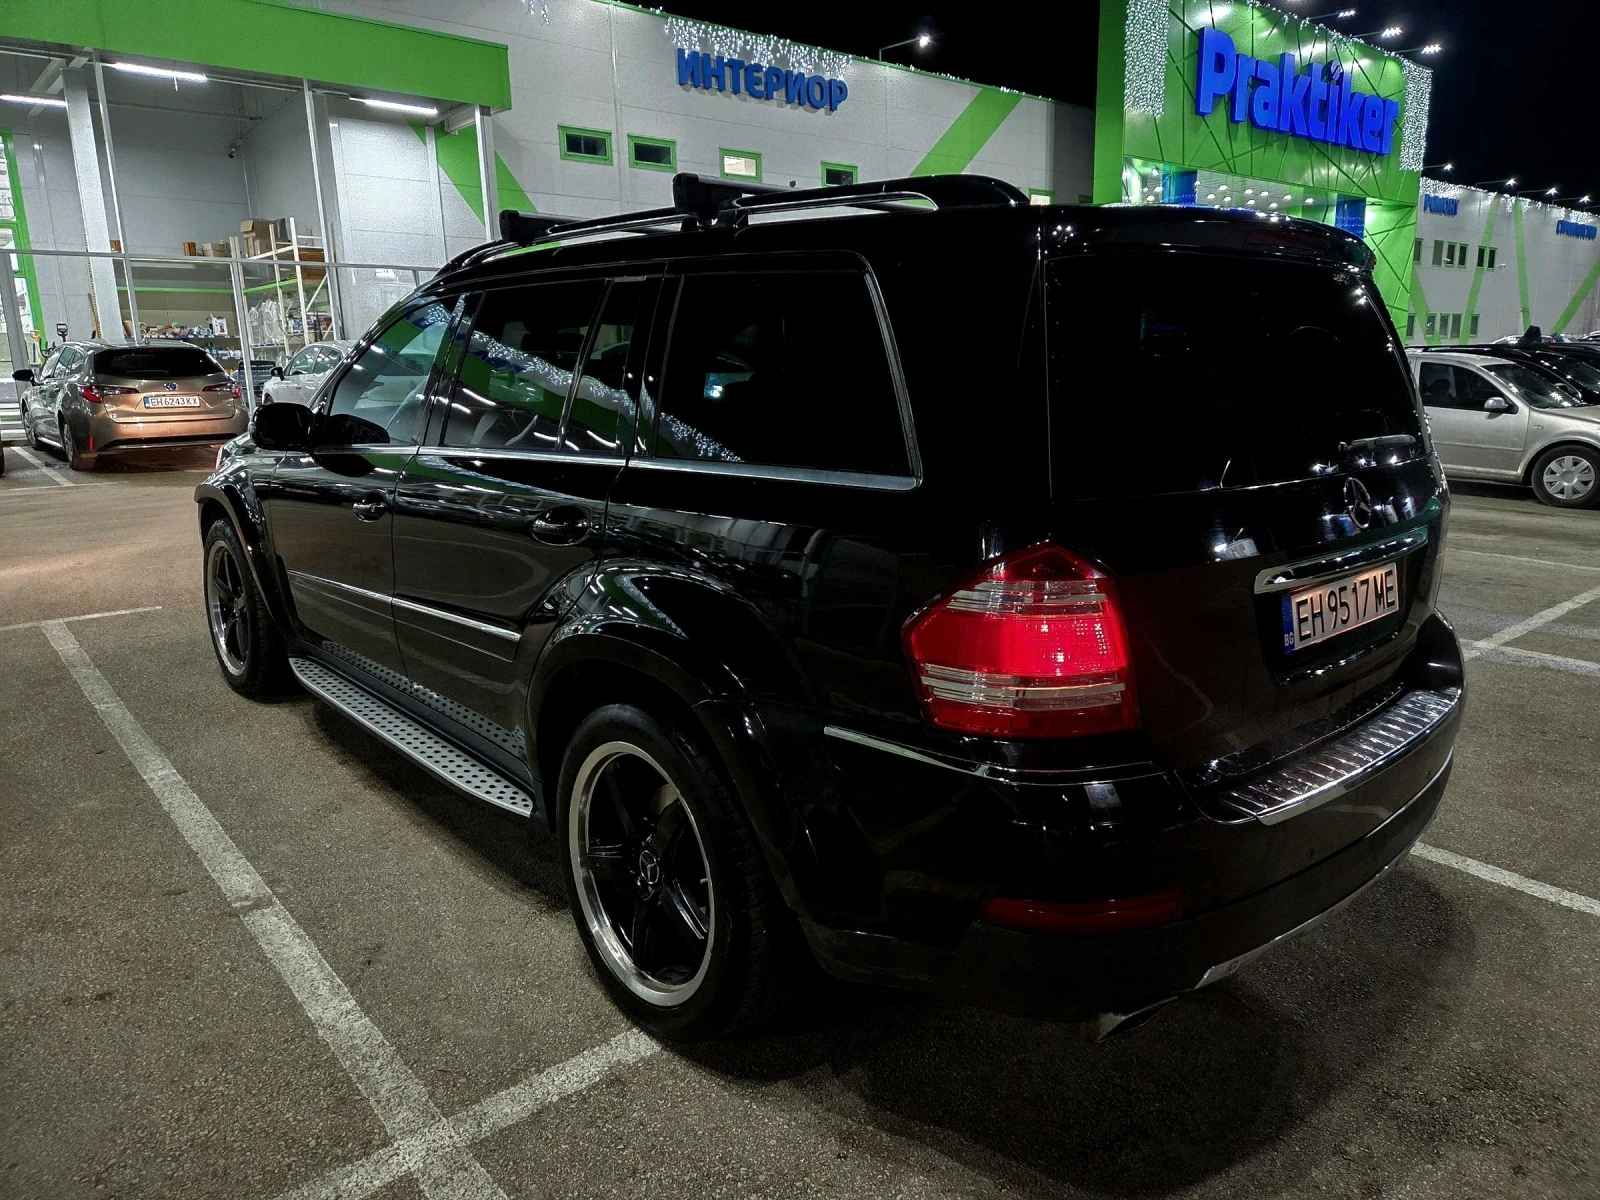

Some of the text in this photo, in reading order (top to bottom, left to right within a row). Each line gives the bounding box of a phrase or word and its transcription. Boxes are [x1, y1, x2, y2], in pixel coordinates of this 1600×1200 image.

[677, 47, 849, 112] ИНТЕРИОР
[1195, 26, 1399, 156] Praktiker
[1284, 632, 1295, 647] BG
